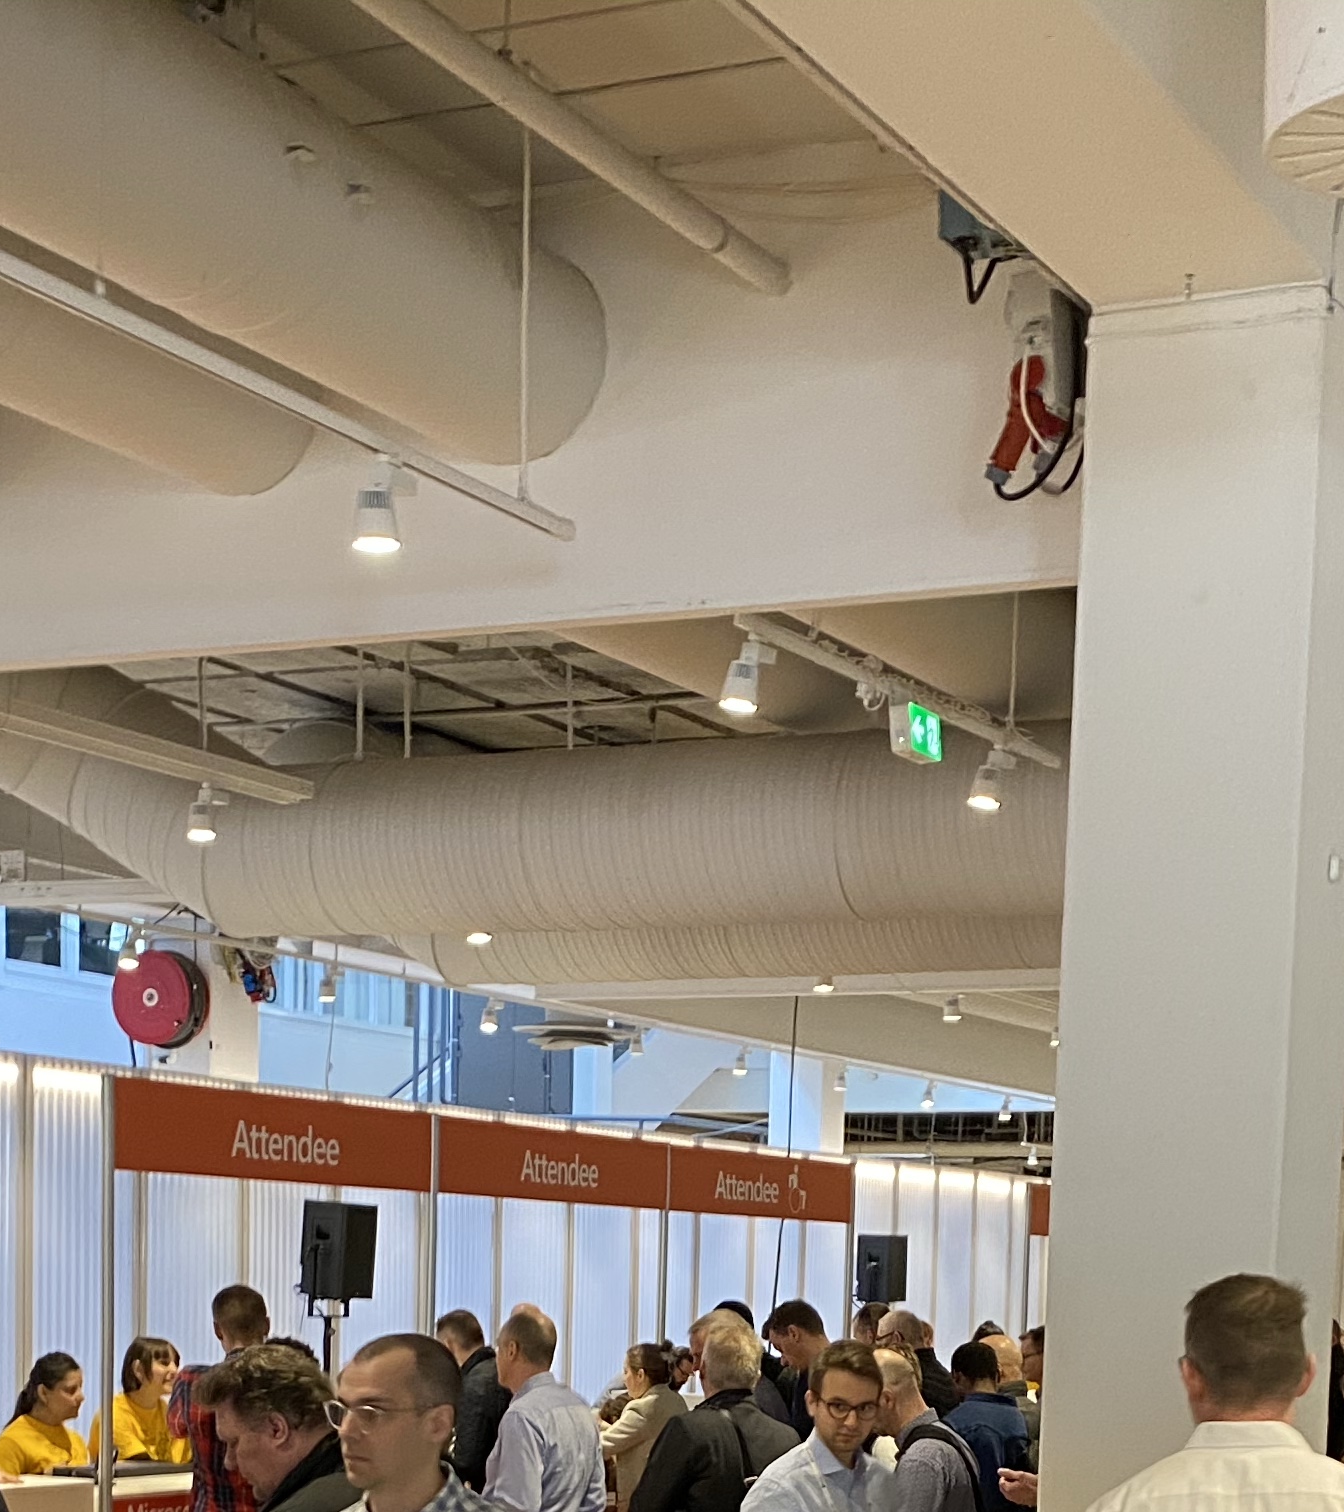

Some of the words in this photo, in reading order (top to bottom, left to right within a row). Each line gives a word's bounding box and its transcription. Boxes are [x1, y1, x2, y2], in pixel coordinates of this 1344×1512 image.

[230, 1119, 340, 1166] Attendee
[520, 1149, 600, 1188] Attendee
[714, 1165, 780, 1204] Attendee
